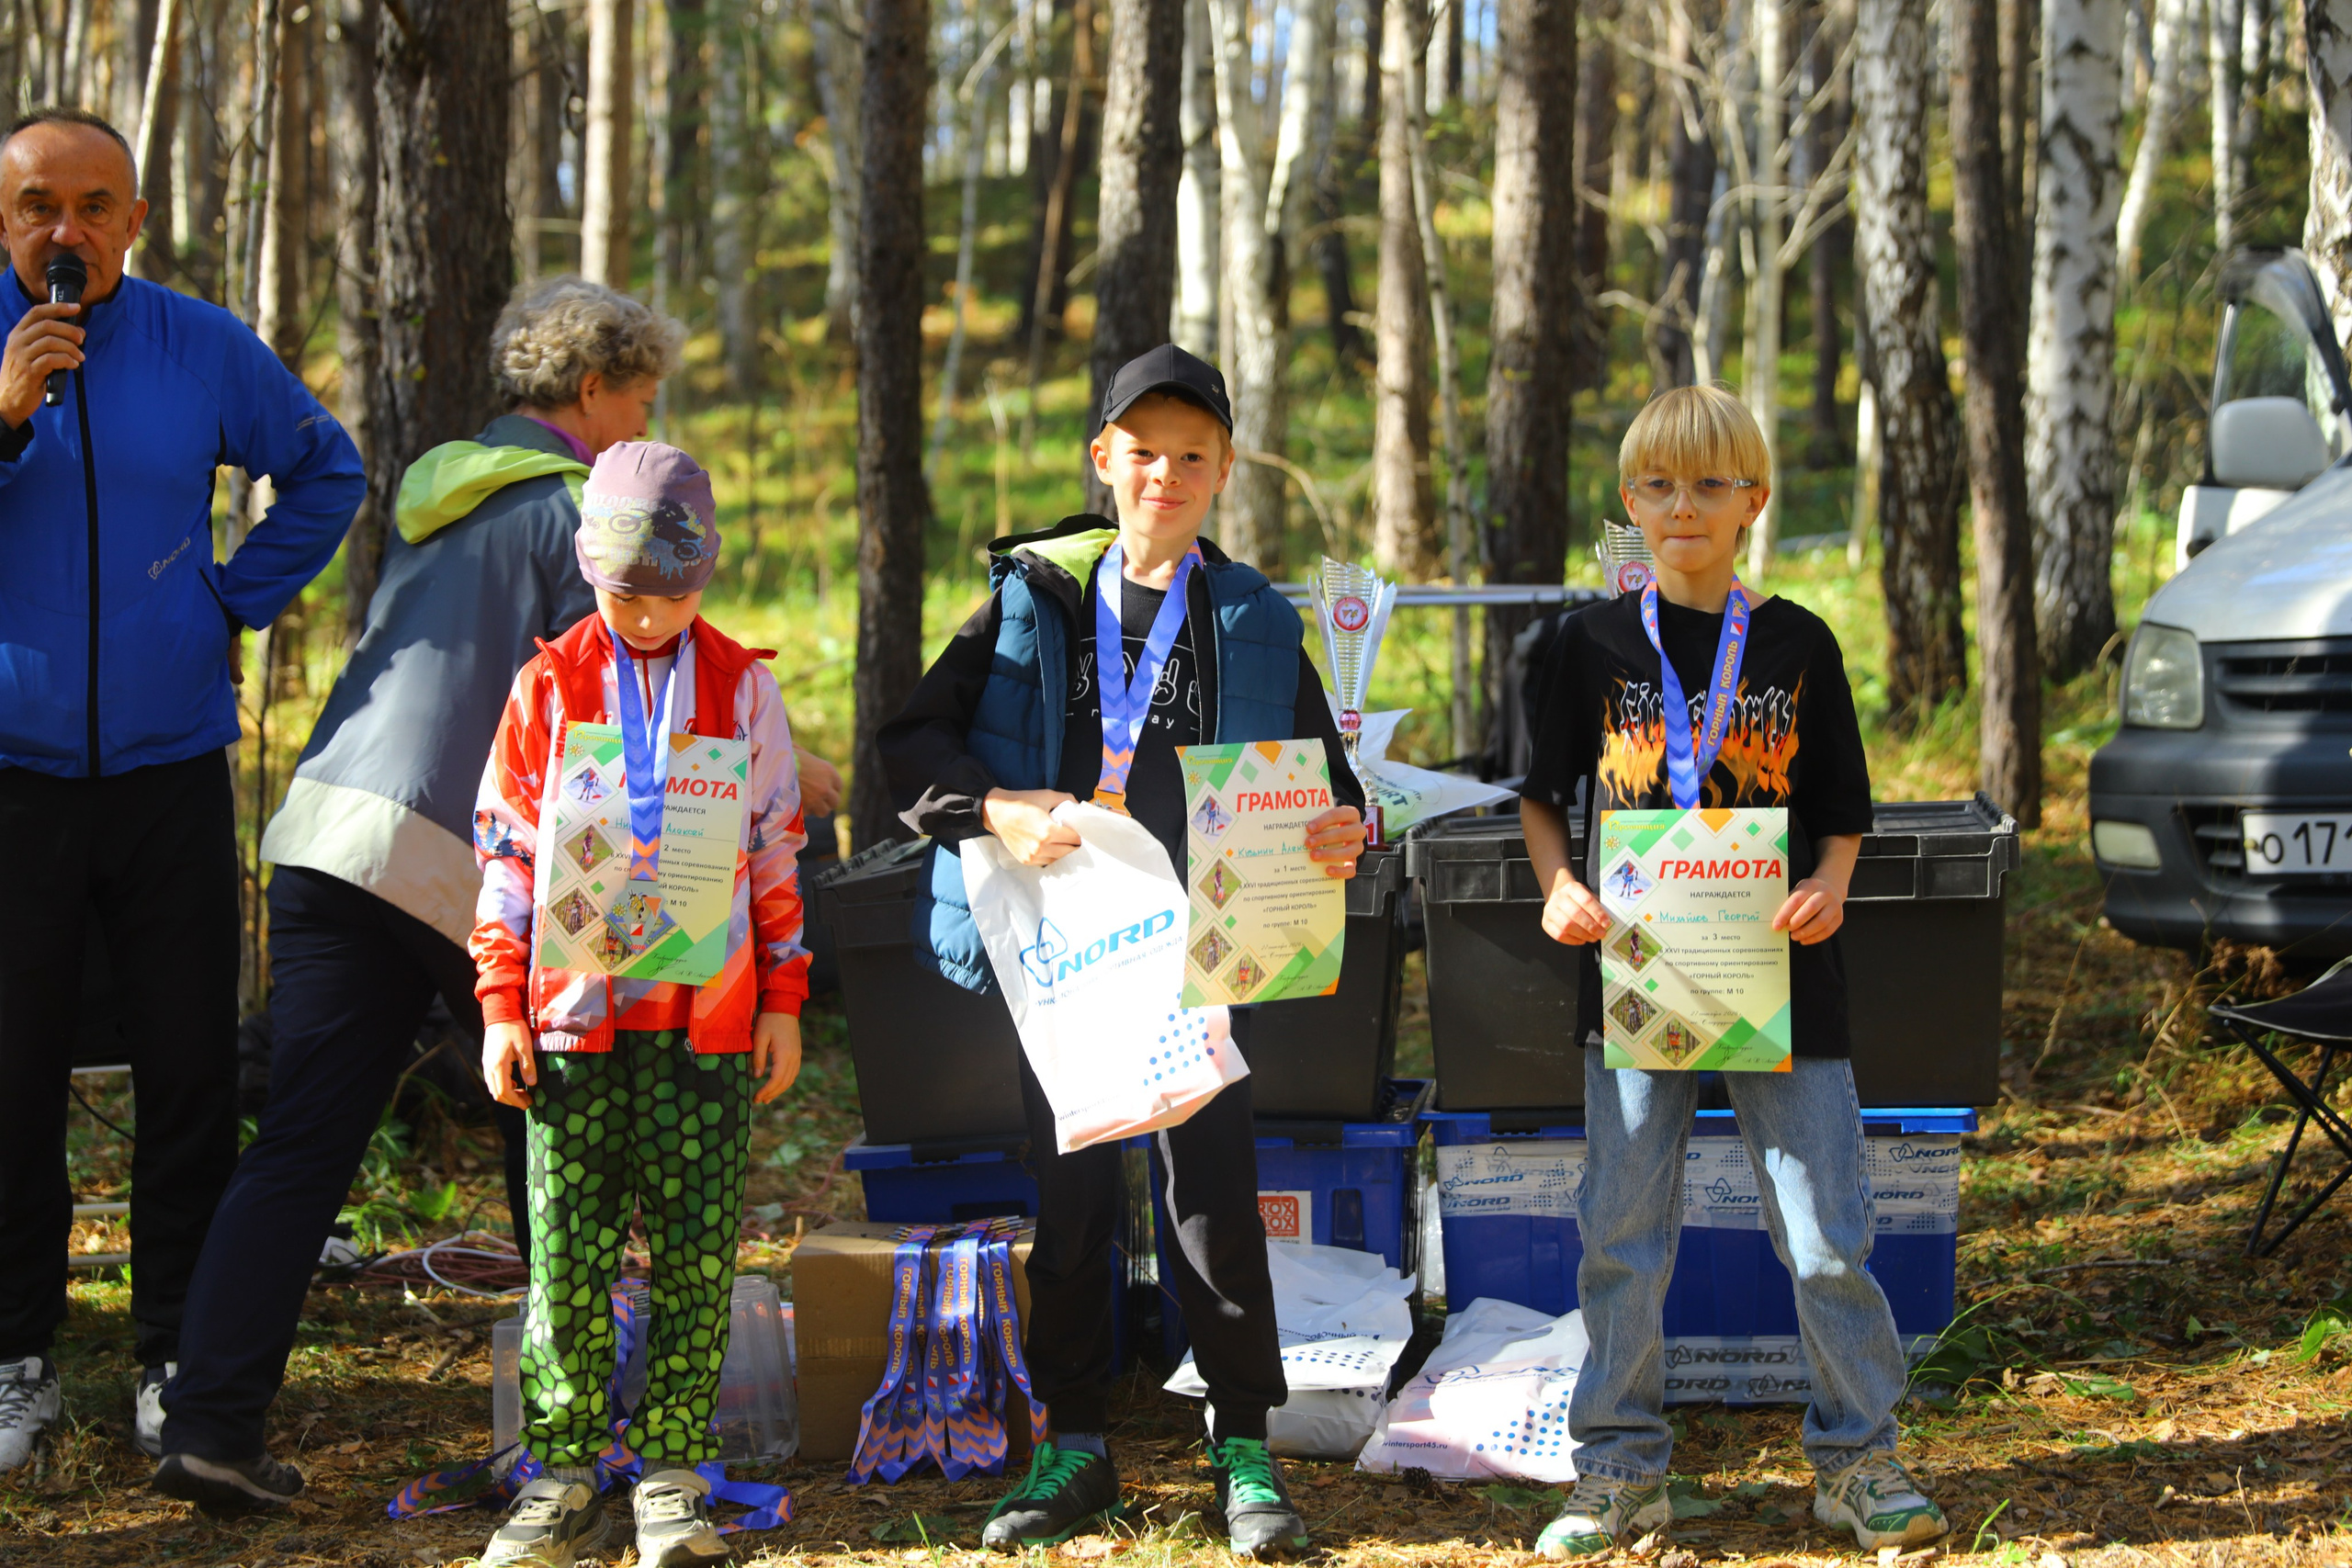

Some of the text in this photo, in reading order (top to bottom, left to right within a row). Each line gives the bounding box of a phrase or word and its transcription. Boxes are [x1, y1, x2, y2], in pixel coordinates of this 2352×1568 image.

[1707, 640, 1738, 746] ГОРНЫЙ КОРОЛЬ
[573, 729, 623, 744] Провинци
[618, 771, 738, 801] МОТА
[1237, 788, 1330, 813] ГРАМОТА
[665, 822, 705, 837] Алексей
[1263, 821, 1308, 831] НАГРАЖДАЕТС
[1365, 822, 1374, 843] 1
[681, 861, 730, 872] соревнованиях
[1658, 859, 1782, 879] ГРАМОТА
[667, 872, 724, 884] ориентированию
[1257, 880, 1298, 888] традиционных
[1251, 893, 1288, 902] спортивному
[1289, 888, 1337, 898] ориентированию
[1690, 891, 1751, 899] НАГРАЖДАЕТСЯ
[1659, 909, 1760, 923] Михайлов Георгий
[1272, 920, 1293, 929] группе:
[1713, 932, 1718, 941] 3
[1057, 908, 1175, 982] NORD
[1464, 1174, 1524, 1186] NORD
[1453, 1196, 1510, 1208] NORD
[1264, 1216, 1295, 1230] OX
[958, 1257, 971, 1365] ГОРНЫЙ КОРОЛЬ
[991, 1261, 1010, 1314] ГОРНЫЙ
[1001, 1318, 1017, 1368] КОРОЛЬ
[891, 1267, 912, 1373] ГОРНЫЙ КОРОЛЬ
[938, 1318, 956, 1368] КОРОЛЬ
[1694, 1351, 1788, 1363] NORD
[1664, 1378, 1731, 1390] ORD
